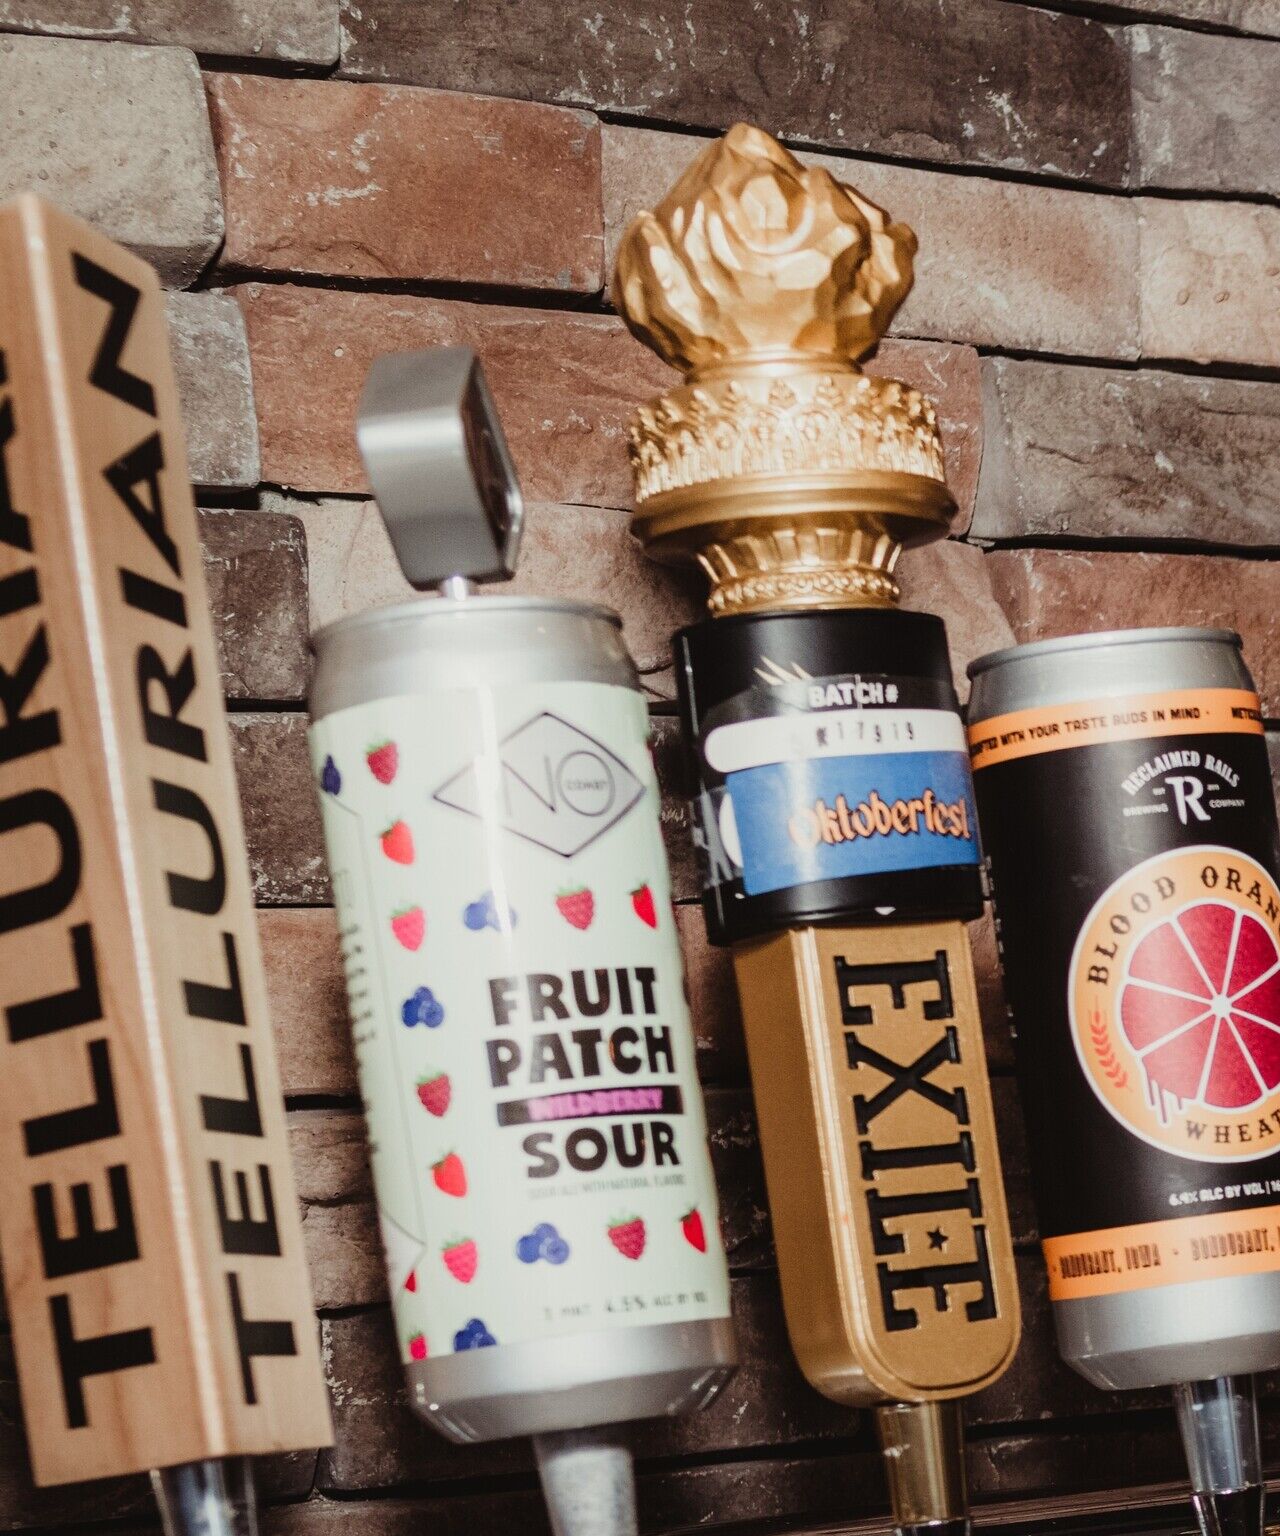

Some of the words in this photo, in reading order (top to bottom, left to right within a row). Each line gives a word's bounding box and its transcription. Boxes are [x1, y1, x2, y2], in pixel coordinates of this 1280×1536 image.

[1029, 724, 1061, 739] YOUR
[1064, 716, 1109, 733] TASTE
[1113, 710, 1148, 727] BUDS
[1152, 708, 1165, 722] IN
[1170, 706, 1200, 720] MIND
[1121, 751, 1200, 797] RECLAIMED
[1204, 753, 1240, 788] RAILS
[72, 250, 298, 1406] TELLURIAN
[788, 788, 971, 850] Oktoberfest
[0, 345, 157, 1430] TELLUR
[1087, 874, 1176, 986] BLOOD
[488, 966, 658, 1026] FRUIT
[485, 1025, 677, 1088] PATCH
[521, 1121, 681, 1179] SOUR
[834, 949, 998, 1333] EXILE
